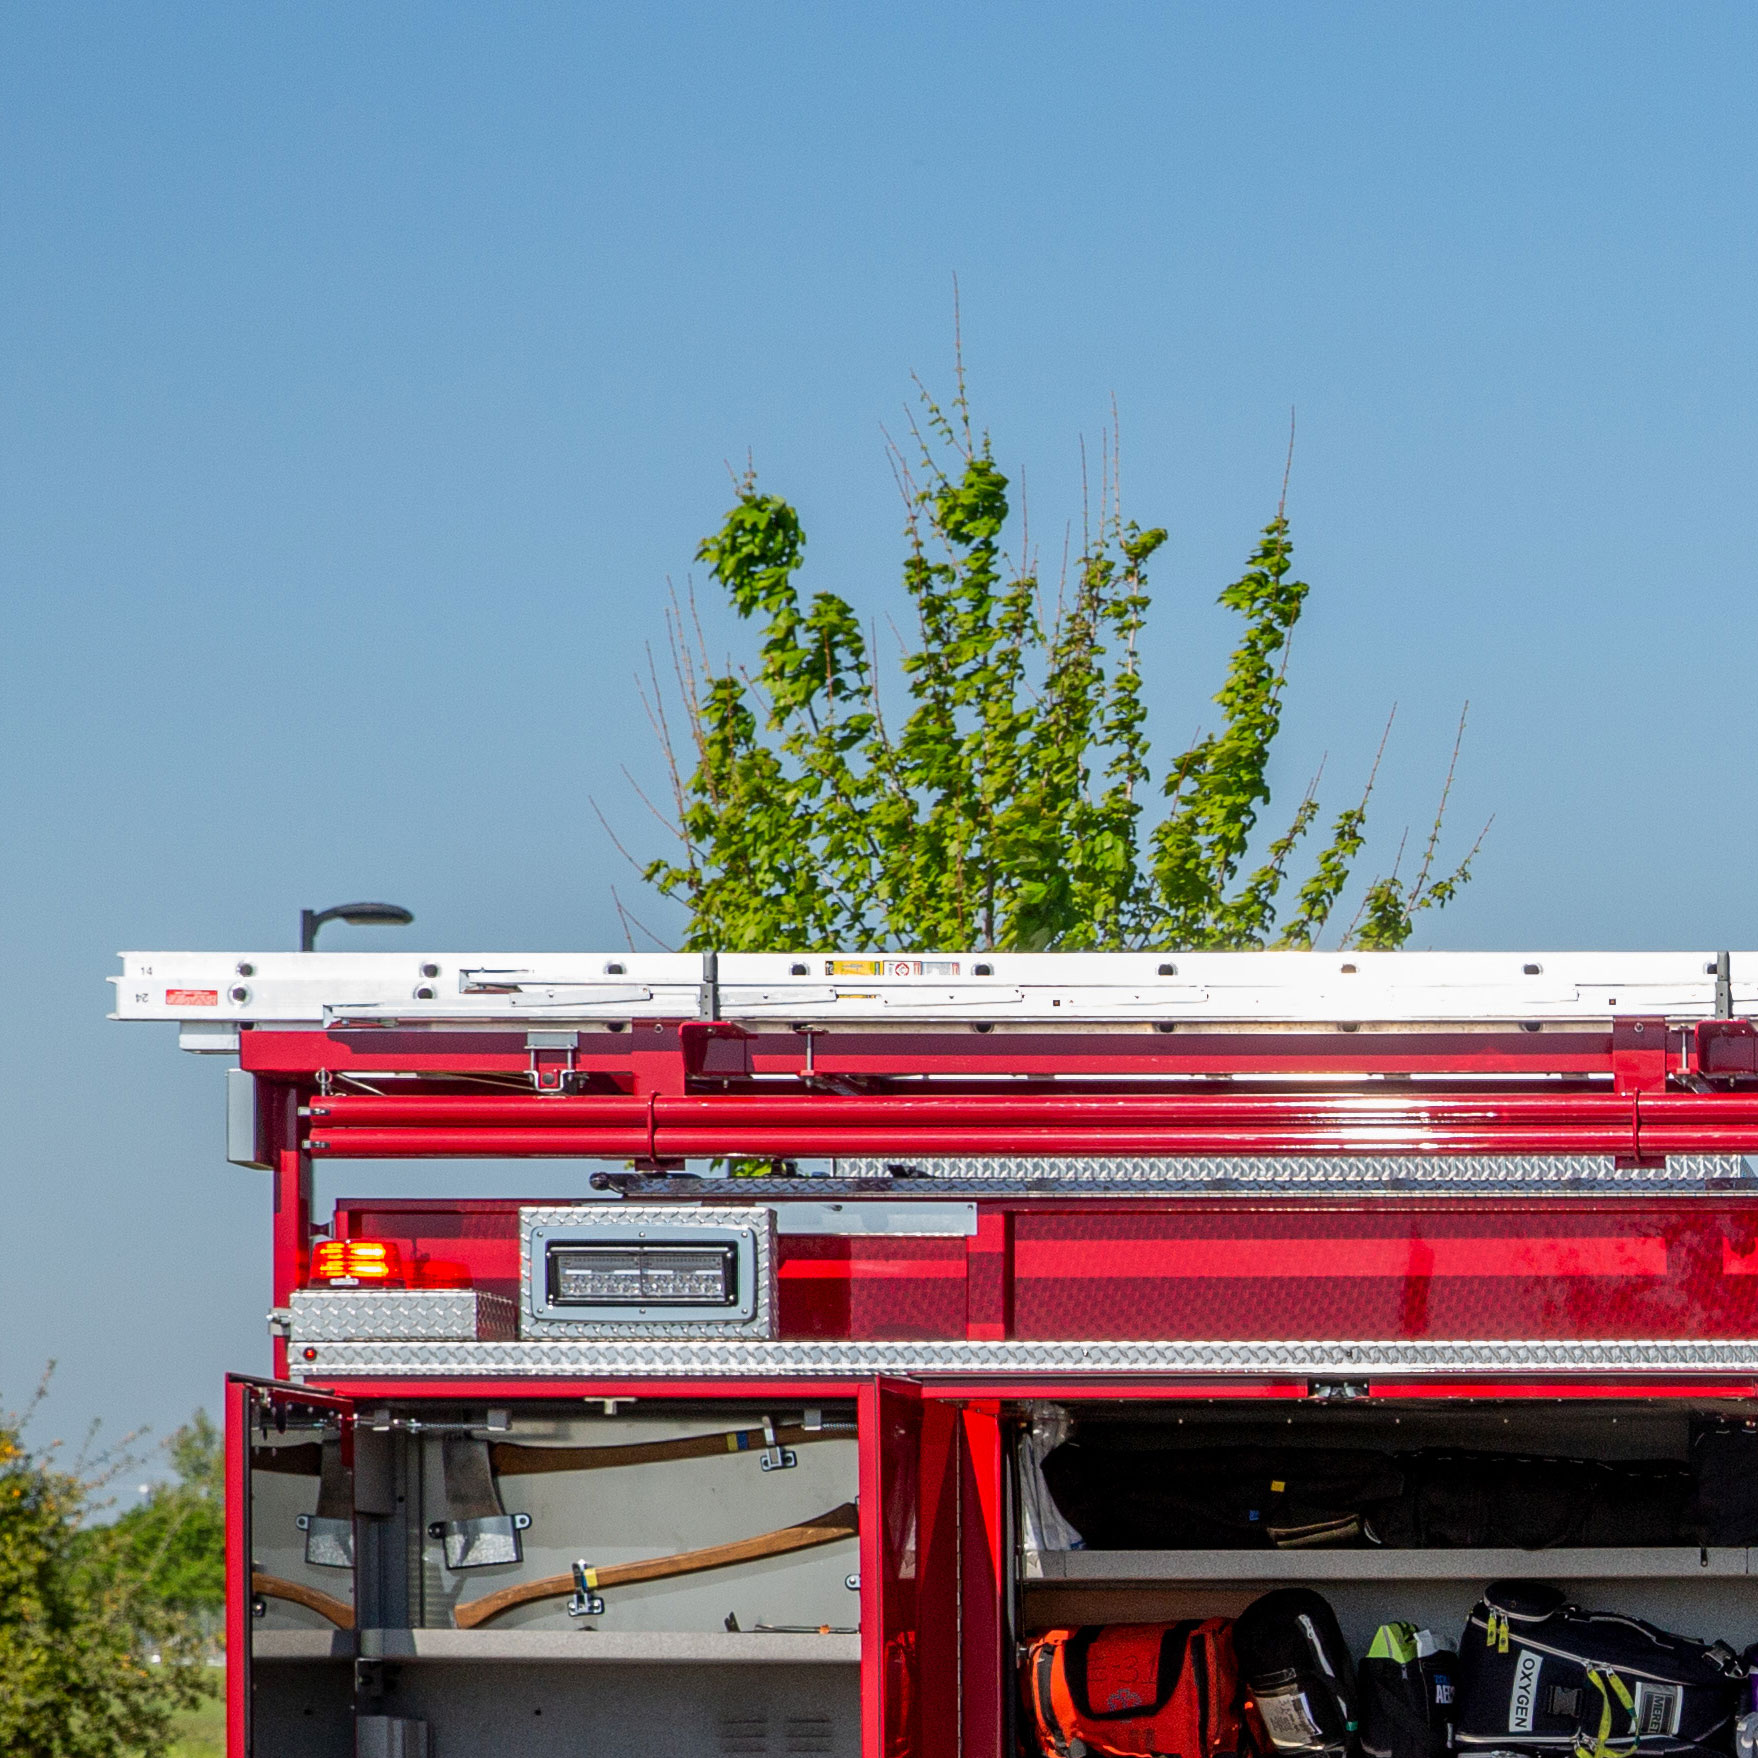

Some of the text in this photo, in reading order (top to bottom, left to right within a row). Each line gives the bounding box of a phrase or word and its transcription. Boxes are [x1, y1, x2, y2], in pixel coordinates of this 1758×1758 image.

[140, 967, 153, 976] 14
[1515, 1658, 1535, 1729] OXYGEN
[1649, 1696, 1666, 1734] MERET
